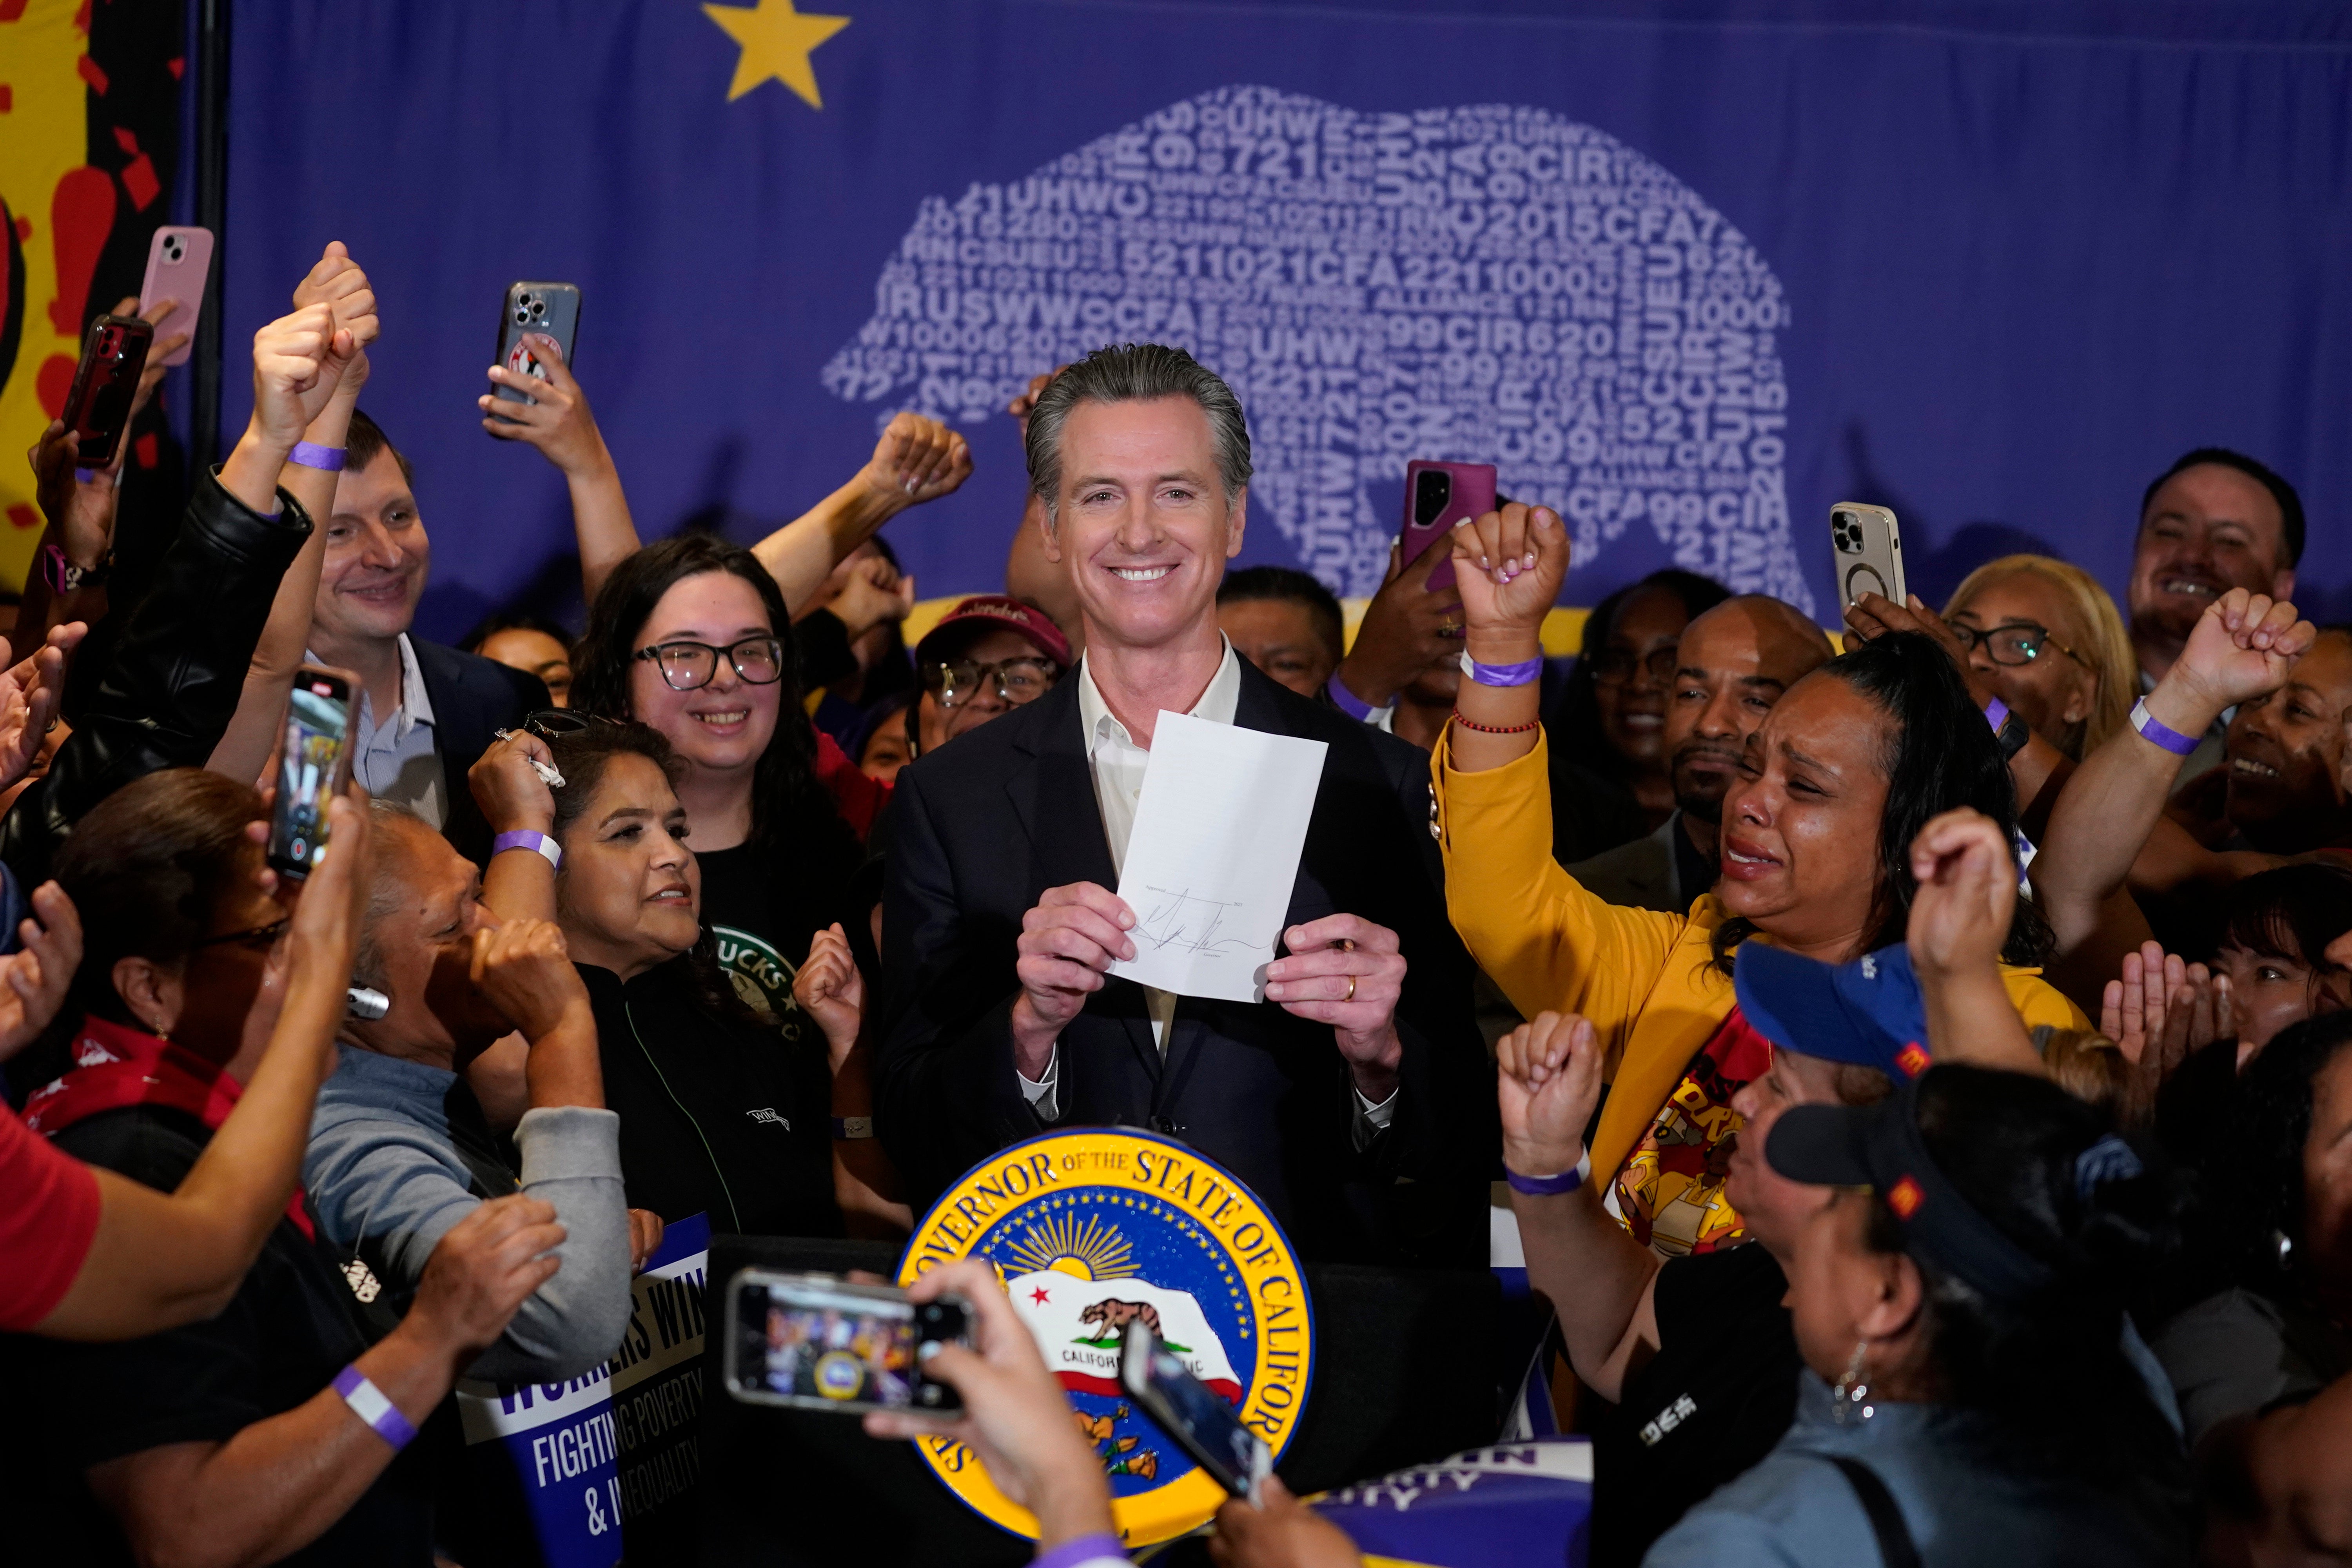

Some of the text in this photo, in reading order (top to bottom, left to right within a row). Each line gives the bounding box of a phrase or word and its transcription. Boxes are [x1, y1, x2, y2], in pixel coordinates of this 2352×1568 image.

[1227, 136, 1316, 178] 721
[1529, 145, 1610, 182] CIR
[1145, 884, 1166, 893] Approved
[718, 940, 787, 990] UCKS
[648, 1267, 705, 1350] WIN
[915, 1149, 1301, 1446] OVERNOR OF THE STATE OF CALIFOR
[1062, 1349, 1120, 1371] CALIFOR
[532, 1367, 704, 1488] FIGHTING POVERTY
[584, 1435, 701, 1536] & INEQUALITY
